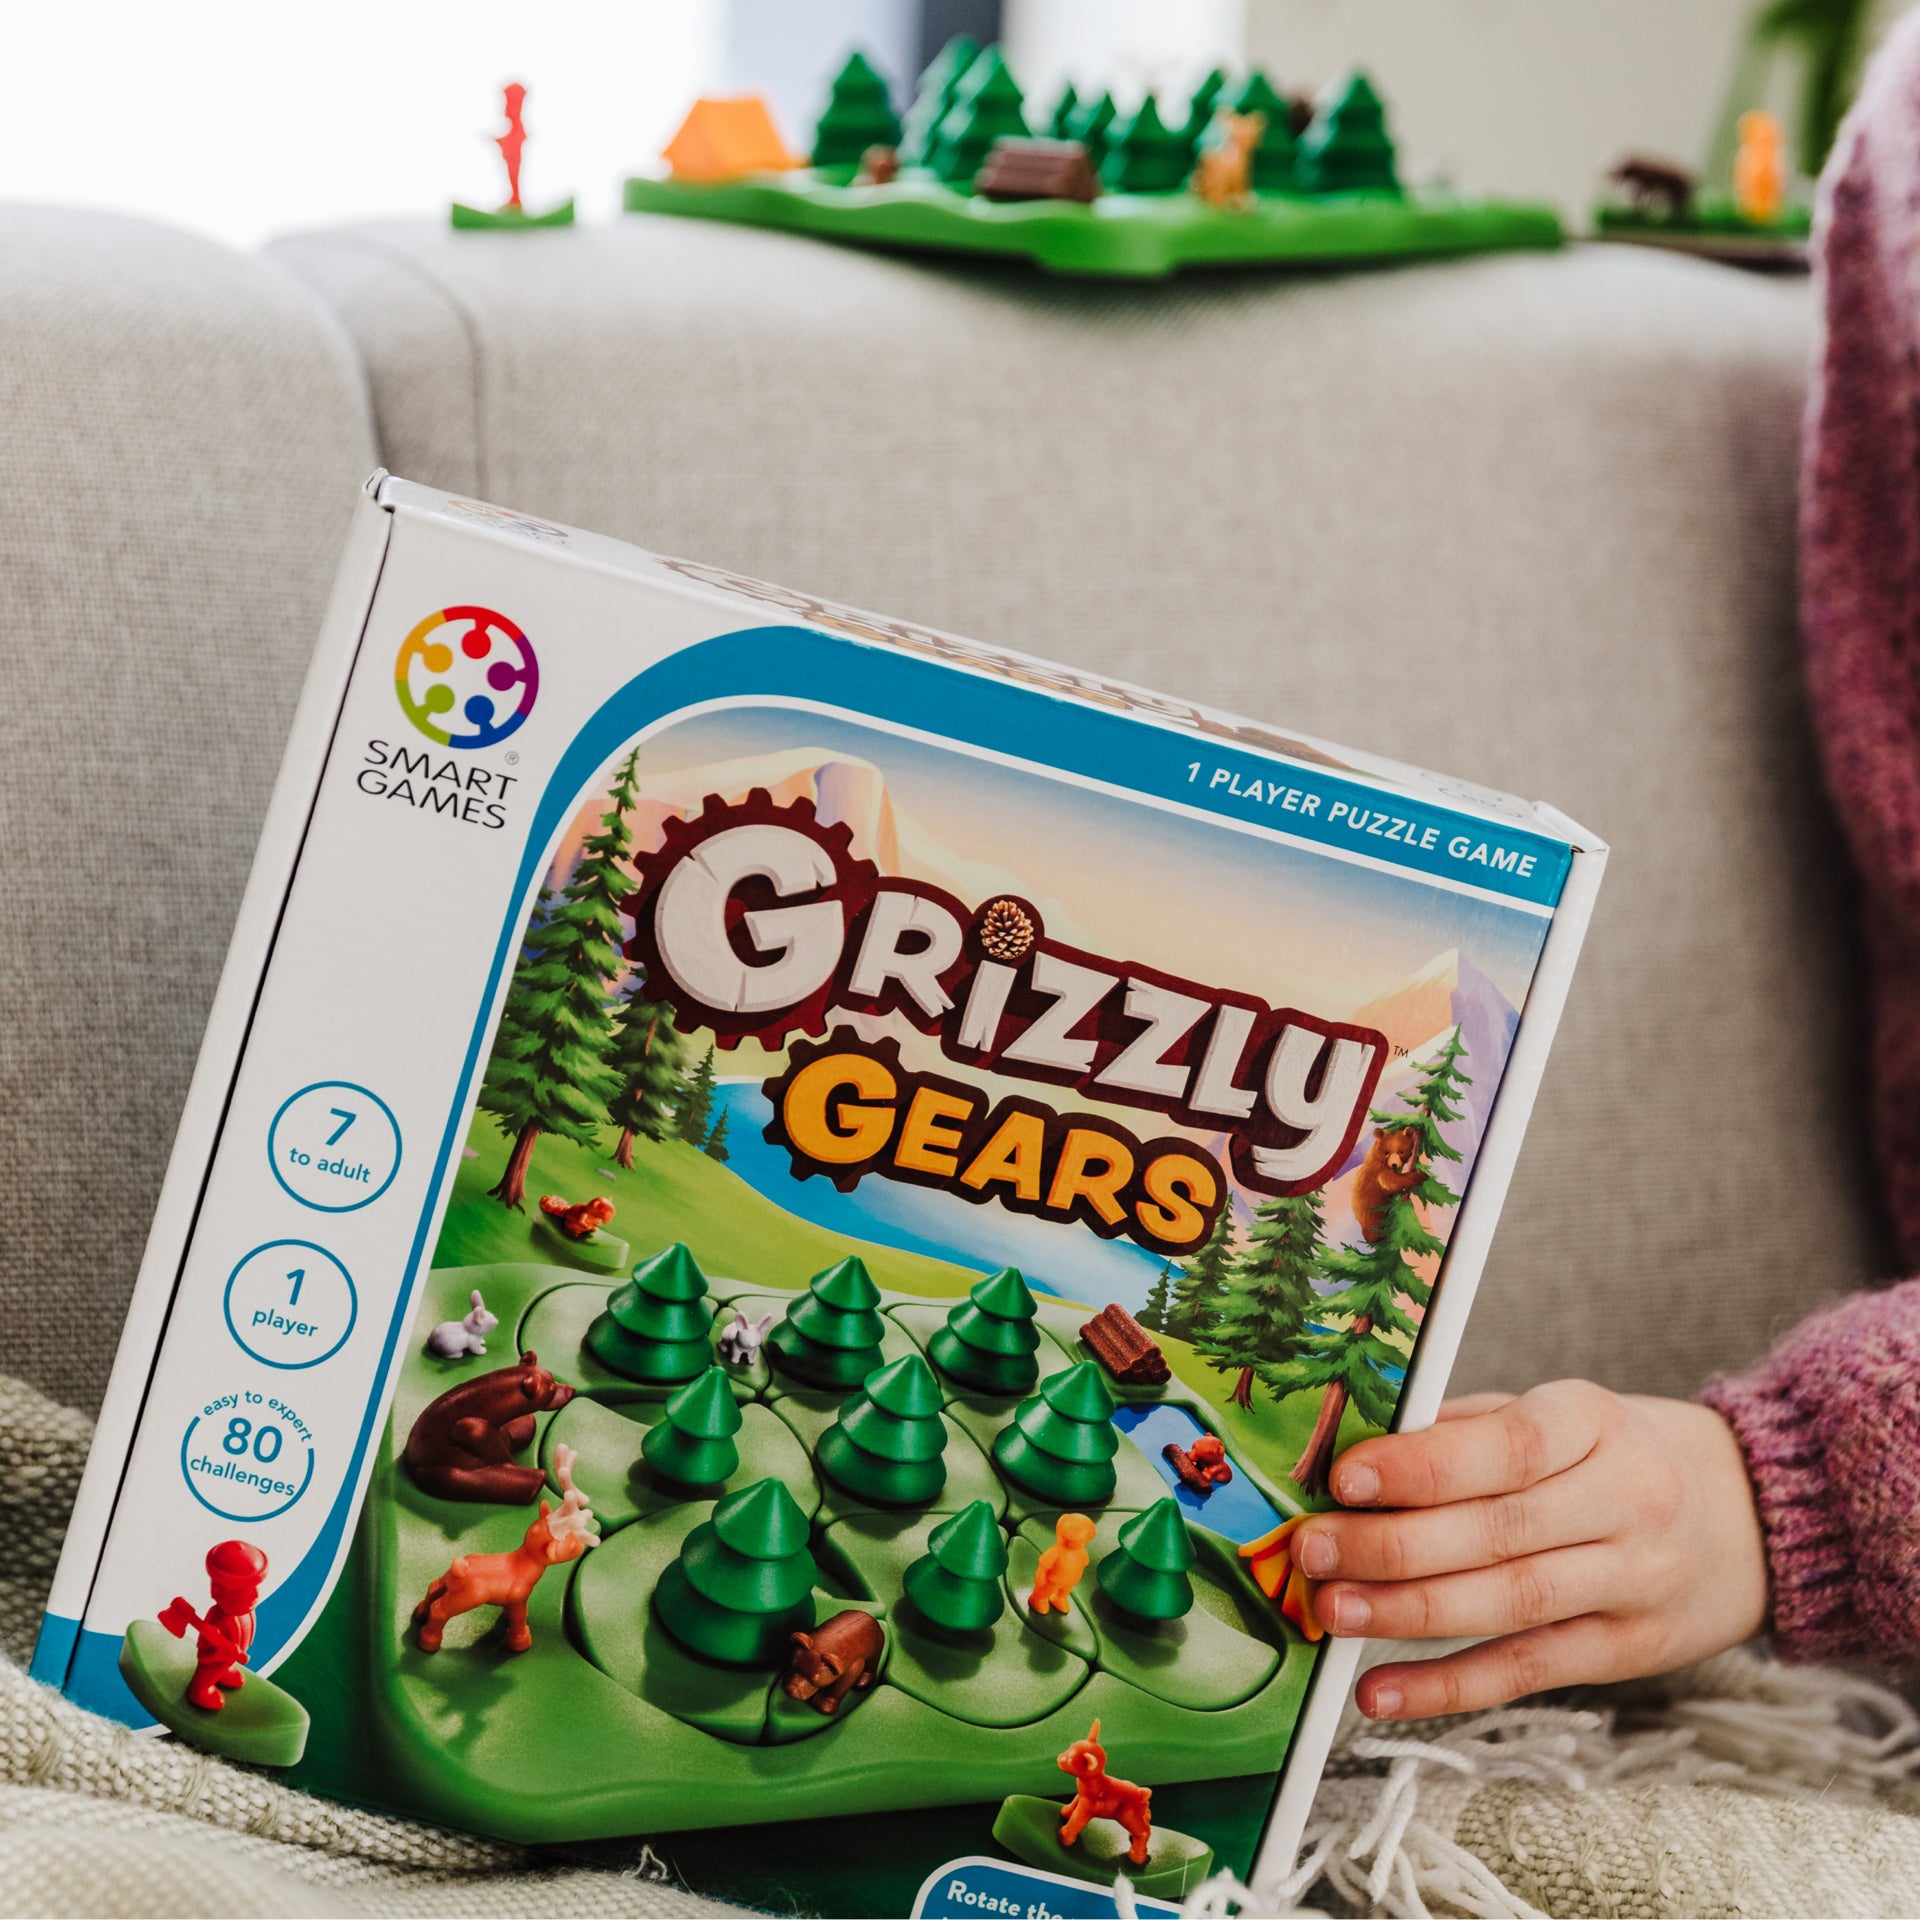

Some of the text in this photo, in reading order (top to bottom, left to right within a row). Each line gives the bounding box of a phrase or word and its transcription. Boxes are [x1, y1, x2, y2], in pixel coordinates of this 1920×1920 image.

[365, 740, 517, 800] SMART
[357, 769, 505, 828] GAMES
[1187, 762, 1537, 878] 1 PLAYER PUZZLE GAME
[325, 1107, 357, 1146] 7
[783, 1053, 1217, 1243] GEARS
[289, 1148, 371, 1183] to adult
[286, 1268, 305, 1306] 1
[251, 1308, 318, 1338] player
[203, 1390, 313, 1442] easy to expert
[222, 1417, 283, 1463] 80
[190, 1455, 296, 1496] challenges
[947, 1880, 1021, 1917] Rotate
